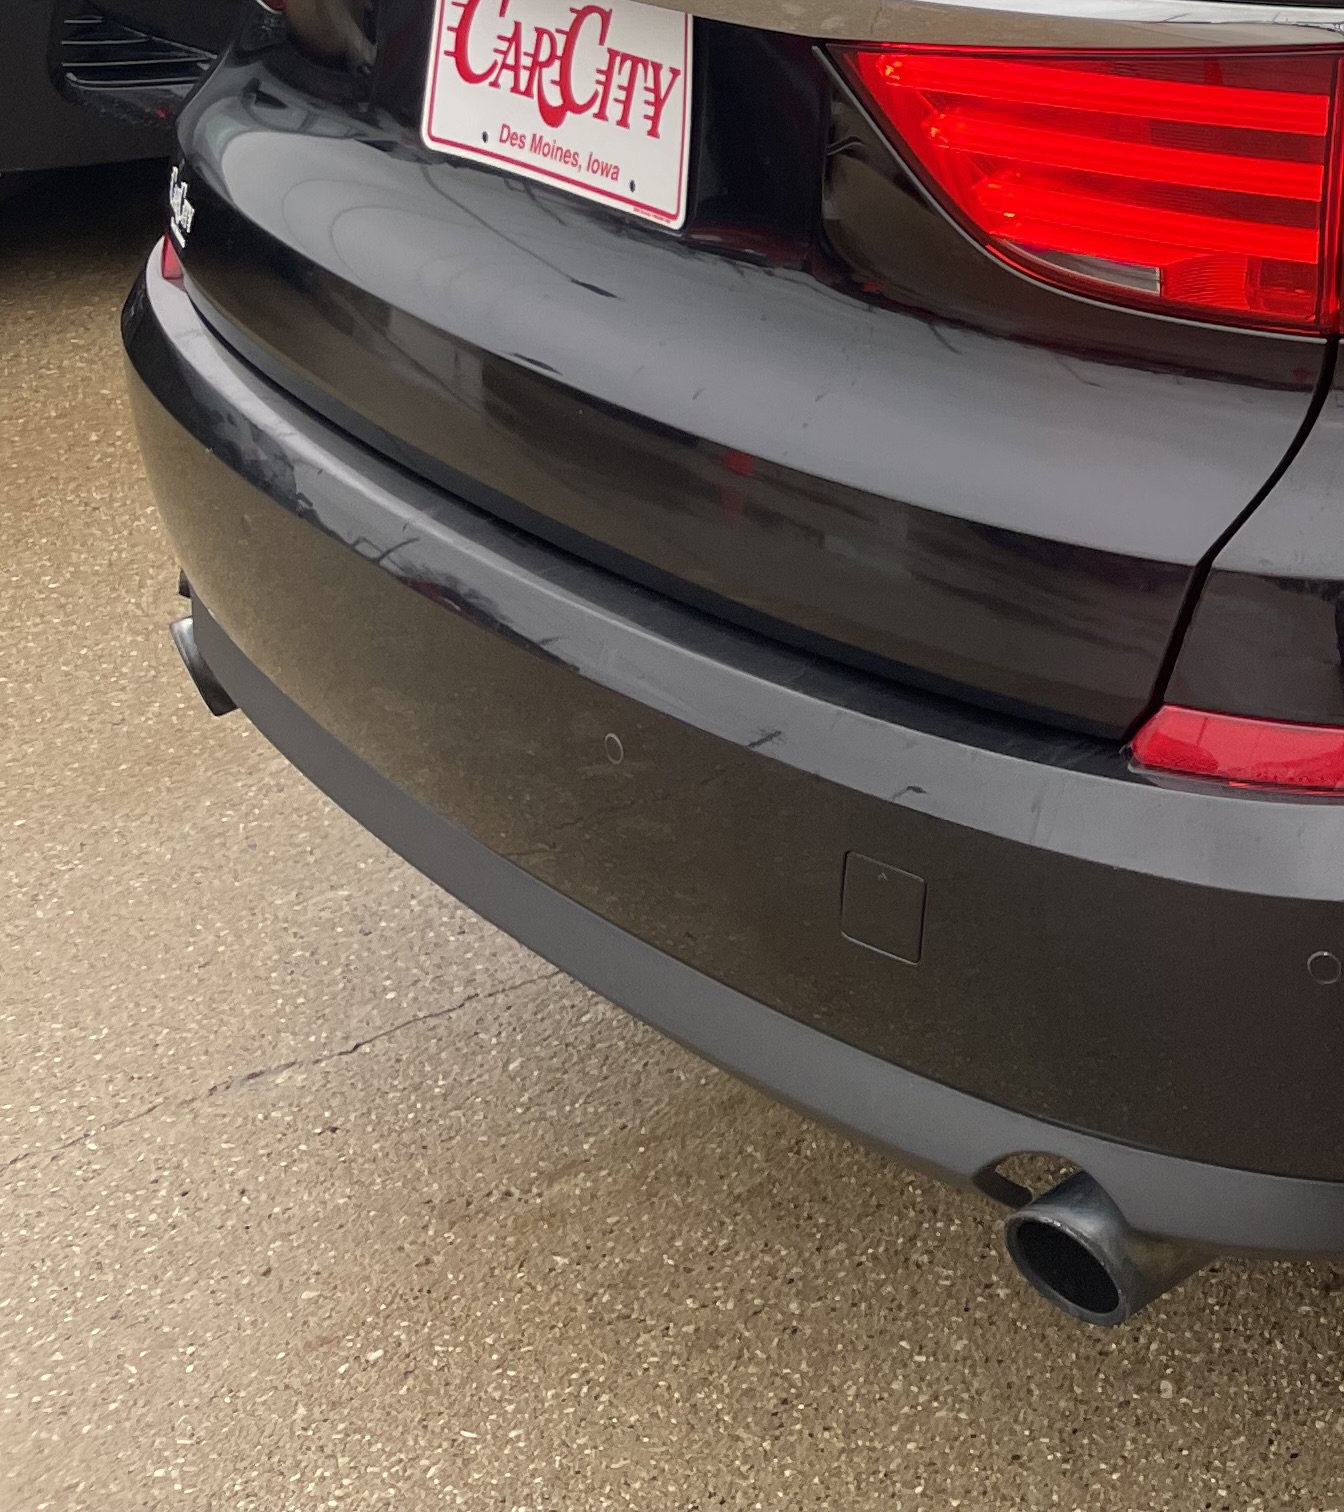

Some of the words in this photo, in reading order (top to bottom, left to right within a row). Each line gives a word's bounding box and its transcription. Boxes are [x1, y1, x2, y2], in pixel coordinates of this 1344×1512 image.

[499, 123, 526, 149] Des
[529, 133, 582, 172] Moines,
[586, 151, 620, 181] Iowa
